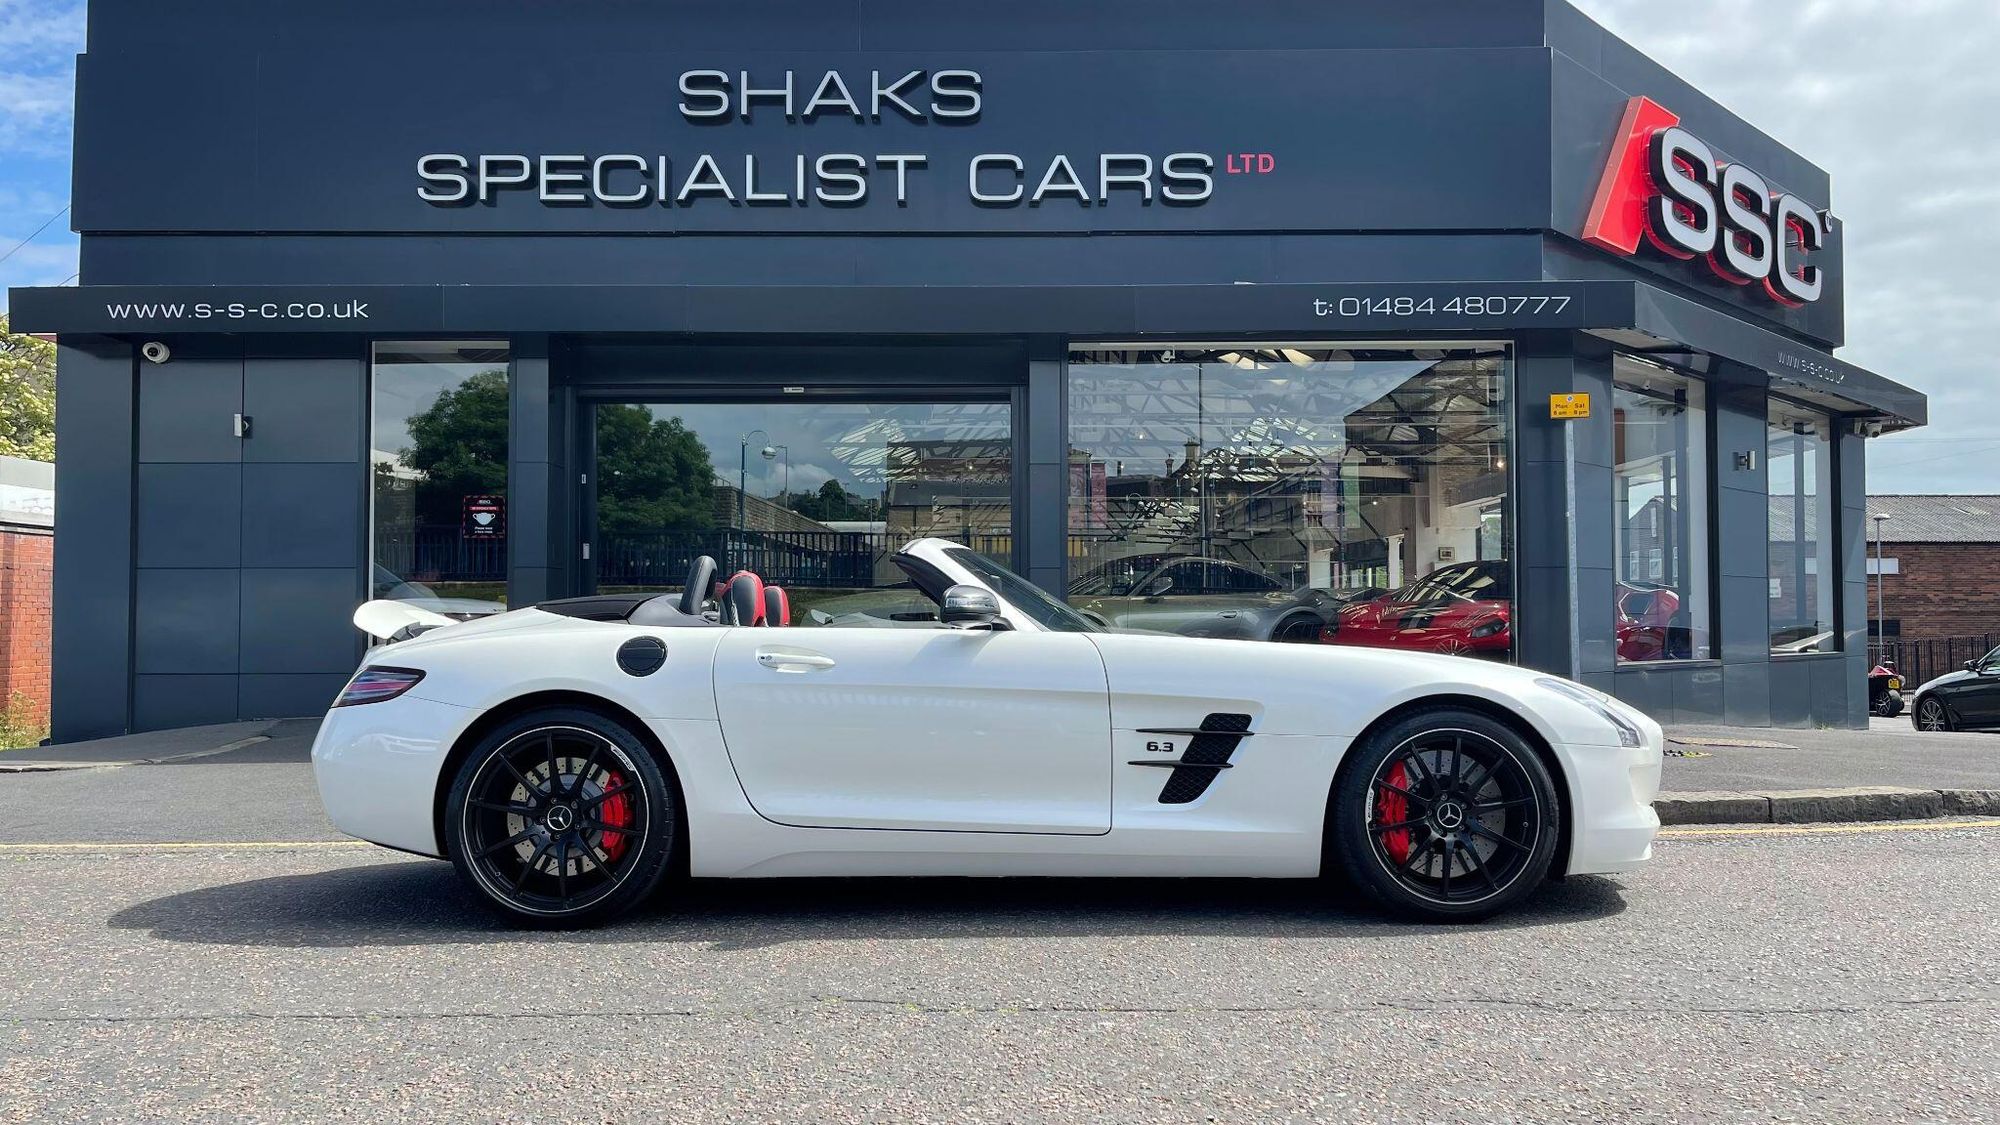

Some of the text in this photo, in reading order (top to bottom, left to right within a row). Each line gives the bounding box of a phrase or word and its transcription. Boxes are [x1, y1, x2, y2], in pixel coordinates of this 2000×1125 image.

[677, 69, 984, 118] SHAKS
[415, 152, 1276, 204] SPECIALIST CARS LTD
[1652, 126, 1823, 303] SSC
[106, 299, 370, 320] www.s-s-c.co.uk
[1338, 297, 1437, 316] 01484
[1441, 295, 1572, 316] 480777
[1146, 741, 1174, 753] 6.3
